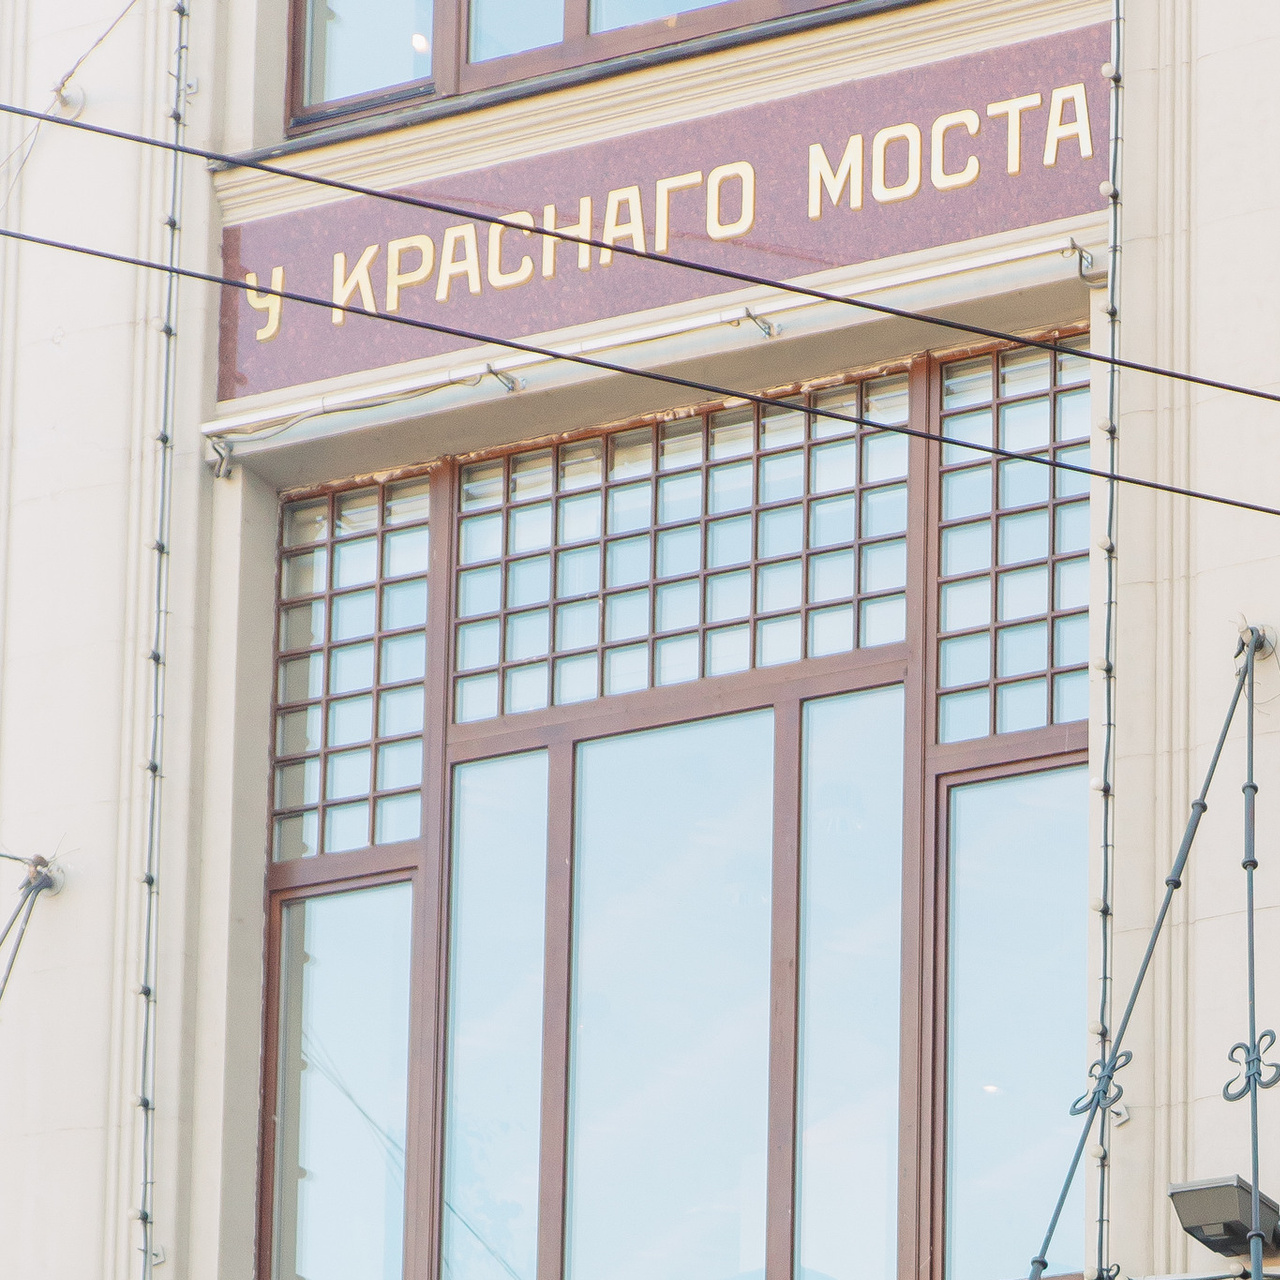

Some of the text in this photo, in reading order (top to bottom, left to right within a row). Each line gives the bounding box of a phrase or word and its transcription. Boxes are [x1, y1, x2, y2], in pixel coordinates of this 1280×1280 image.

[244, 82, 1094, 342] У КРАСНАГО МОСТА
